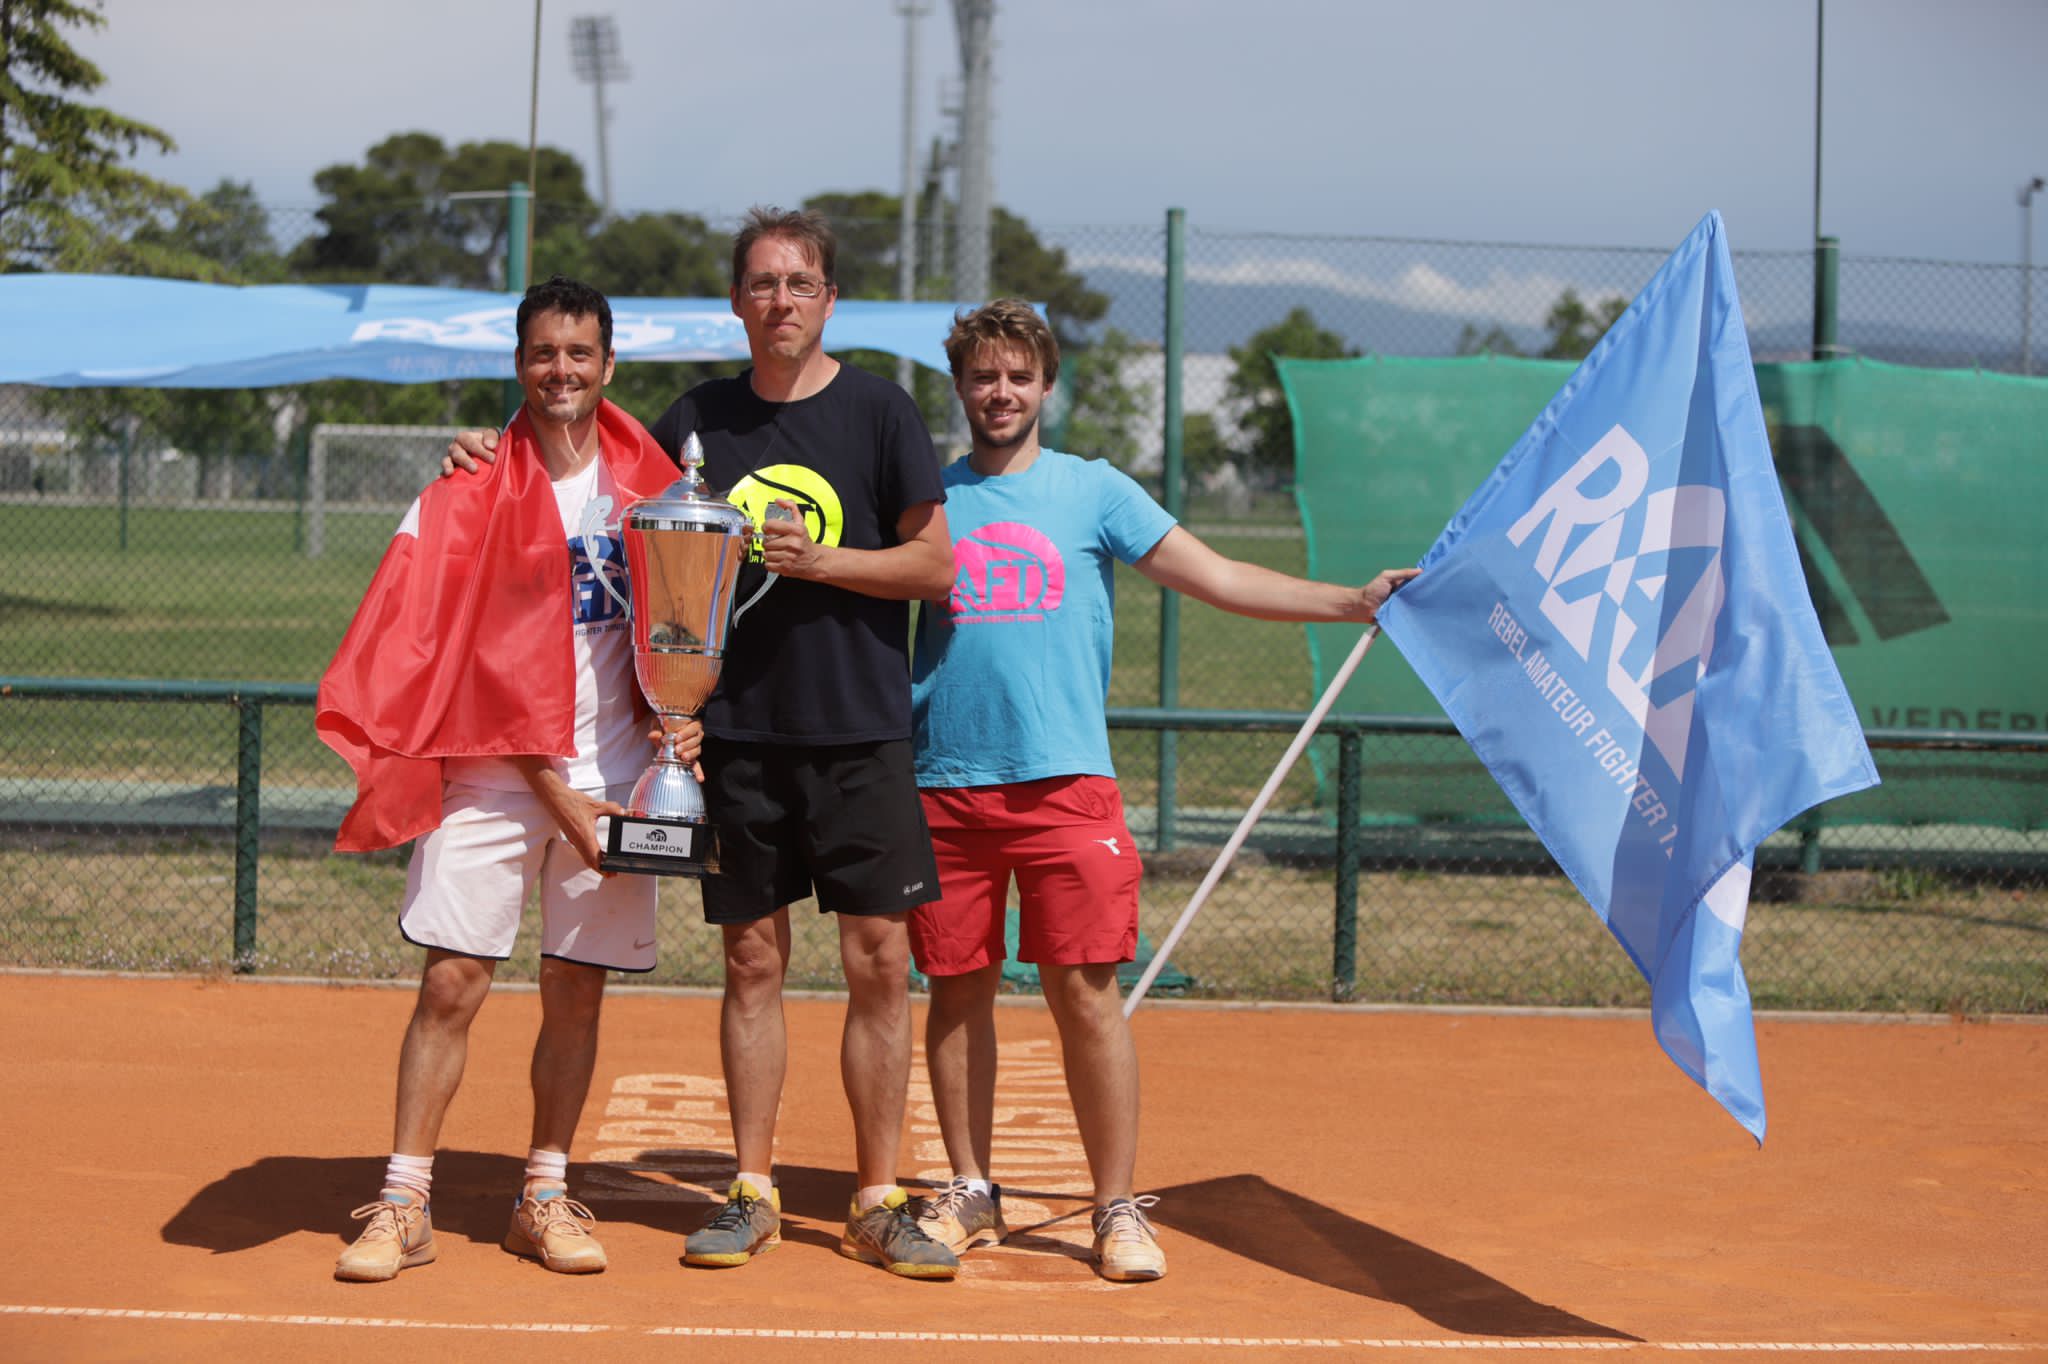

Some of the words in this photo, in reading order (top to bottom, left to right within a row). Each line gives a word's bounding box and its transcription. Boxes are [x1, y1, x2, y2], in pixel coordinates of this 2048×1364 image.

[1487, 601, 1529, 663] REBEL
[1522, 649, 1597, 737] AMATEUR
[1584, 728, 1669, 828] FIGHTER
[628, 841, 684, 854] CHAMPION
